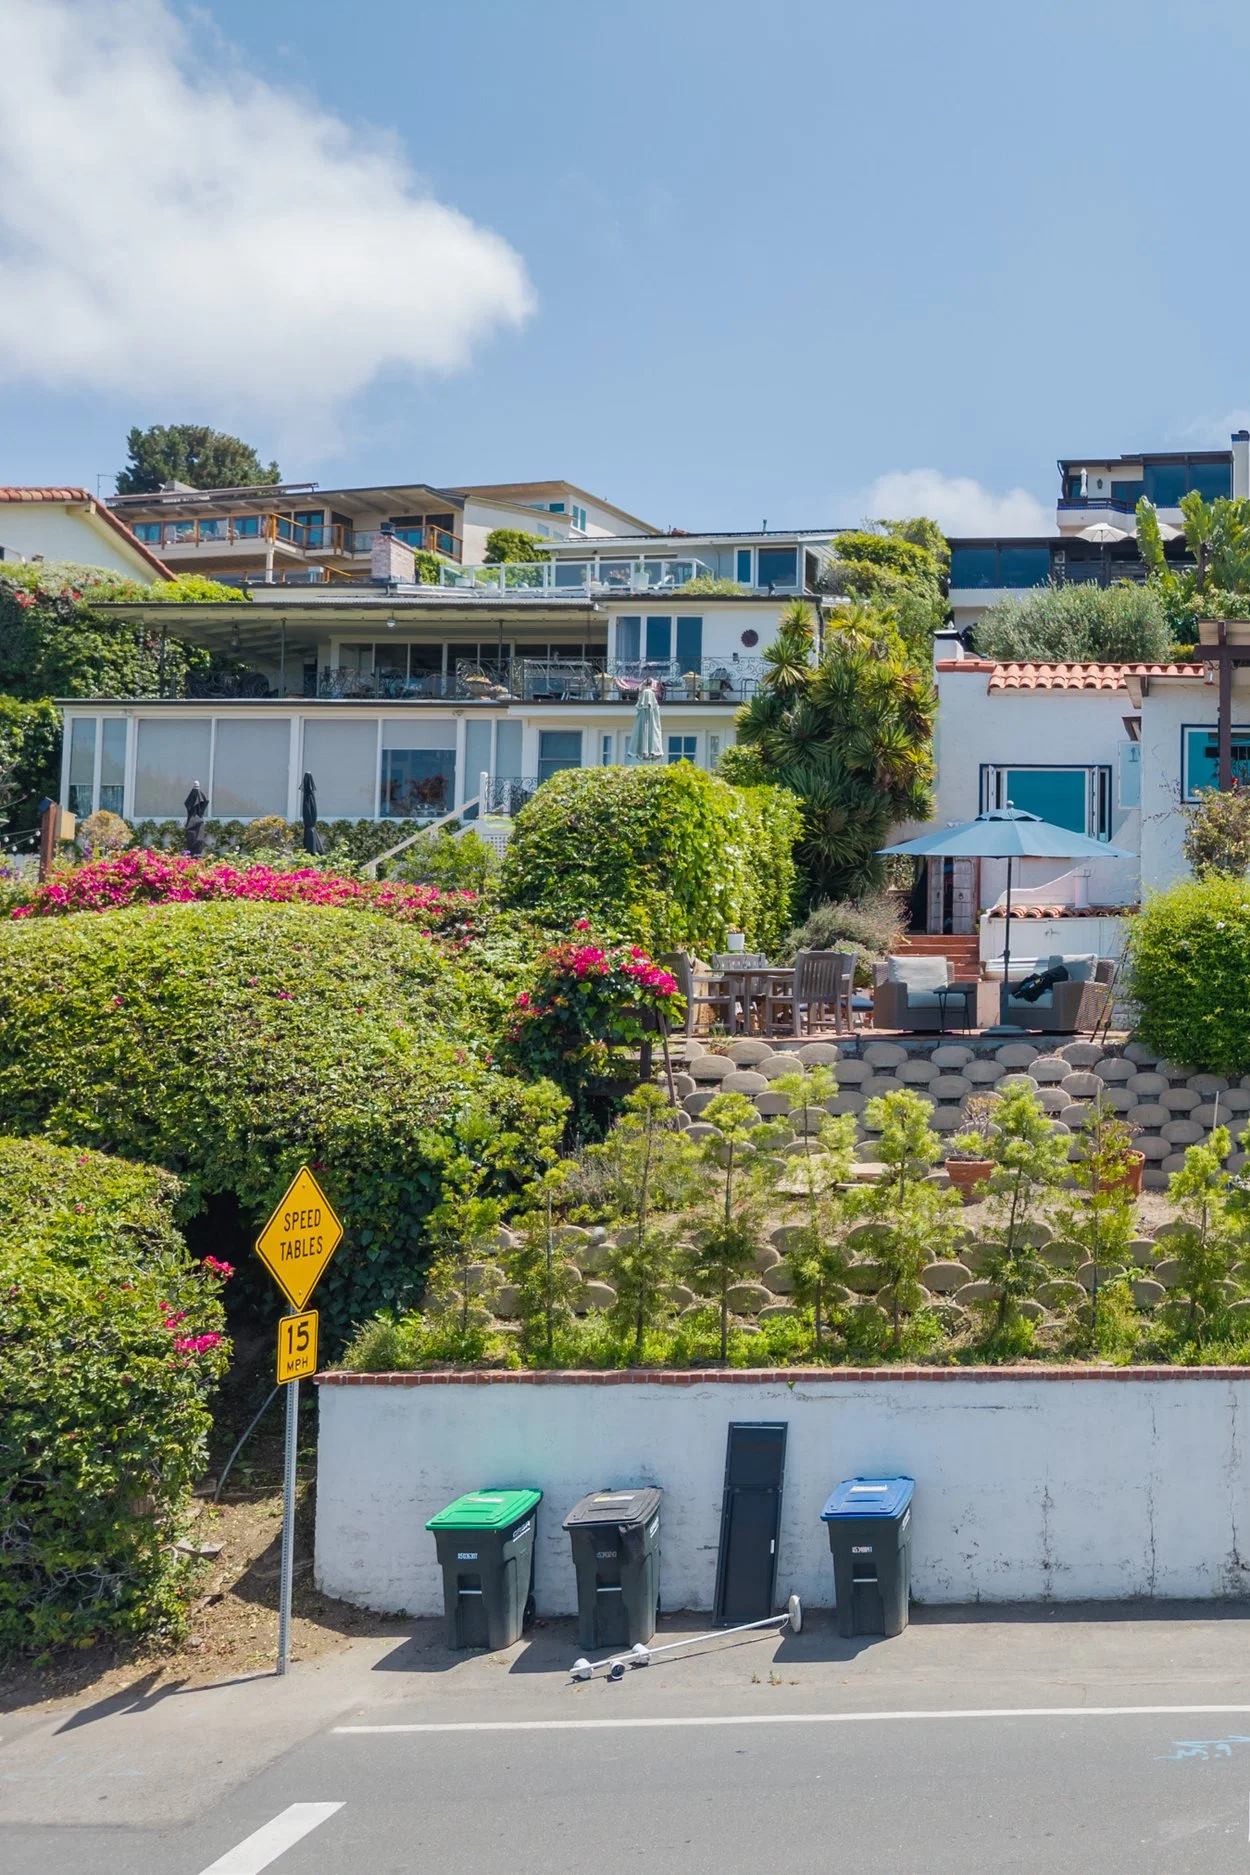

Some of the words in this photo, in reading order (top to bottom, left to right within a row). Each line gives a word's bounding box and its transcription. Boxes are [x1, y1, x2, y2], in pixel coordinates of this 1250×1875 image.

[284, 1208, 321, 1232] SPEED
[280, 1235, 323, 1261] TABLES
[288, 1321, 309, 1354] 15
[287, 1356, 308, 1373] MPH
